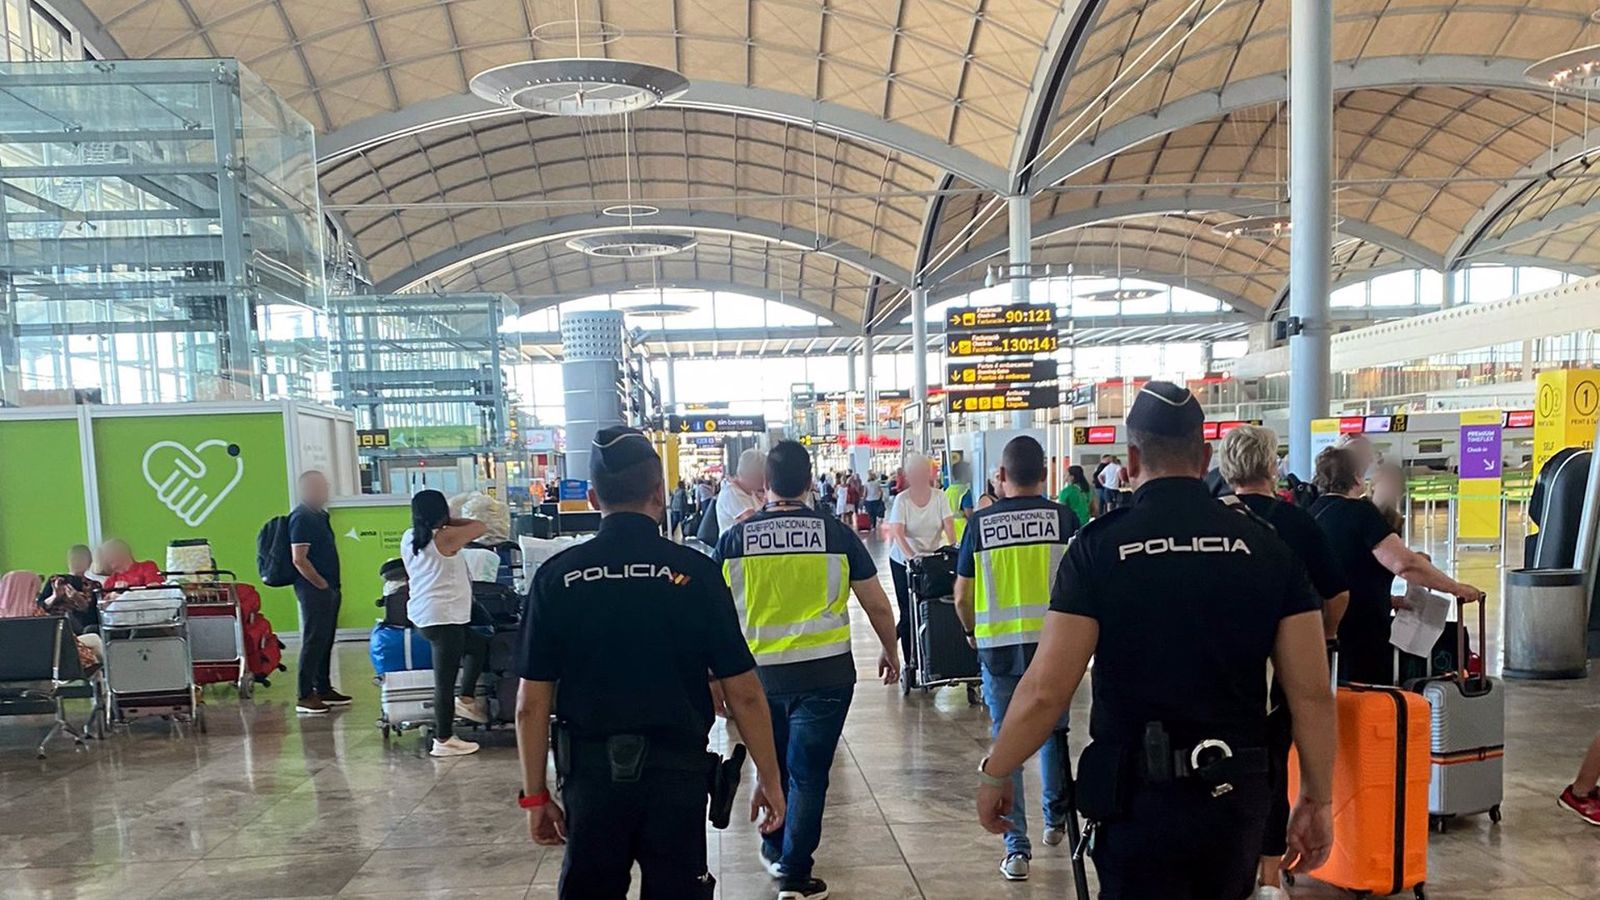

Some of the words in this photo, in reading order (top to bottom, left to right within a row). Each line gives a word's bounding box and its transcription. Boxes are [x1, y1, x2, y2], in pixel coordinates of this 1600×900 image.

[1005, 309, 1051, 323] 90:121
[1002, 336, 1057, 352] 130:141
[775, 519, 811, 529] NACIONAL
[1011, 512, 1045, 521] NACIONAL
[746, 531, 822, 551] POLICIA
[983, 521, 1056, 543] POLICIA
[1118, 537, 1252, 561] POLICIA
[563, 564, 674, 588] POLICIA
